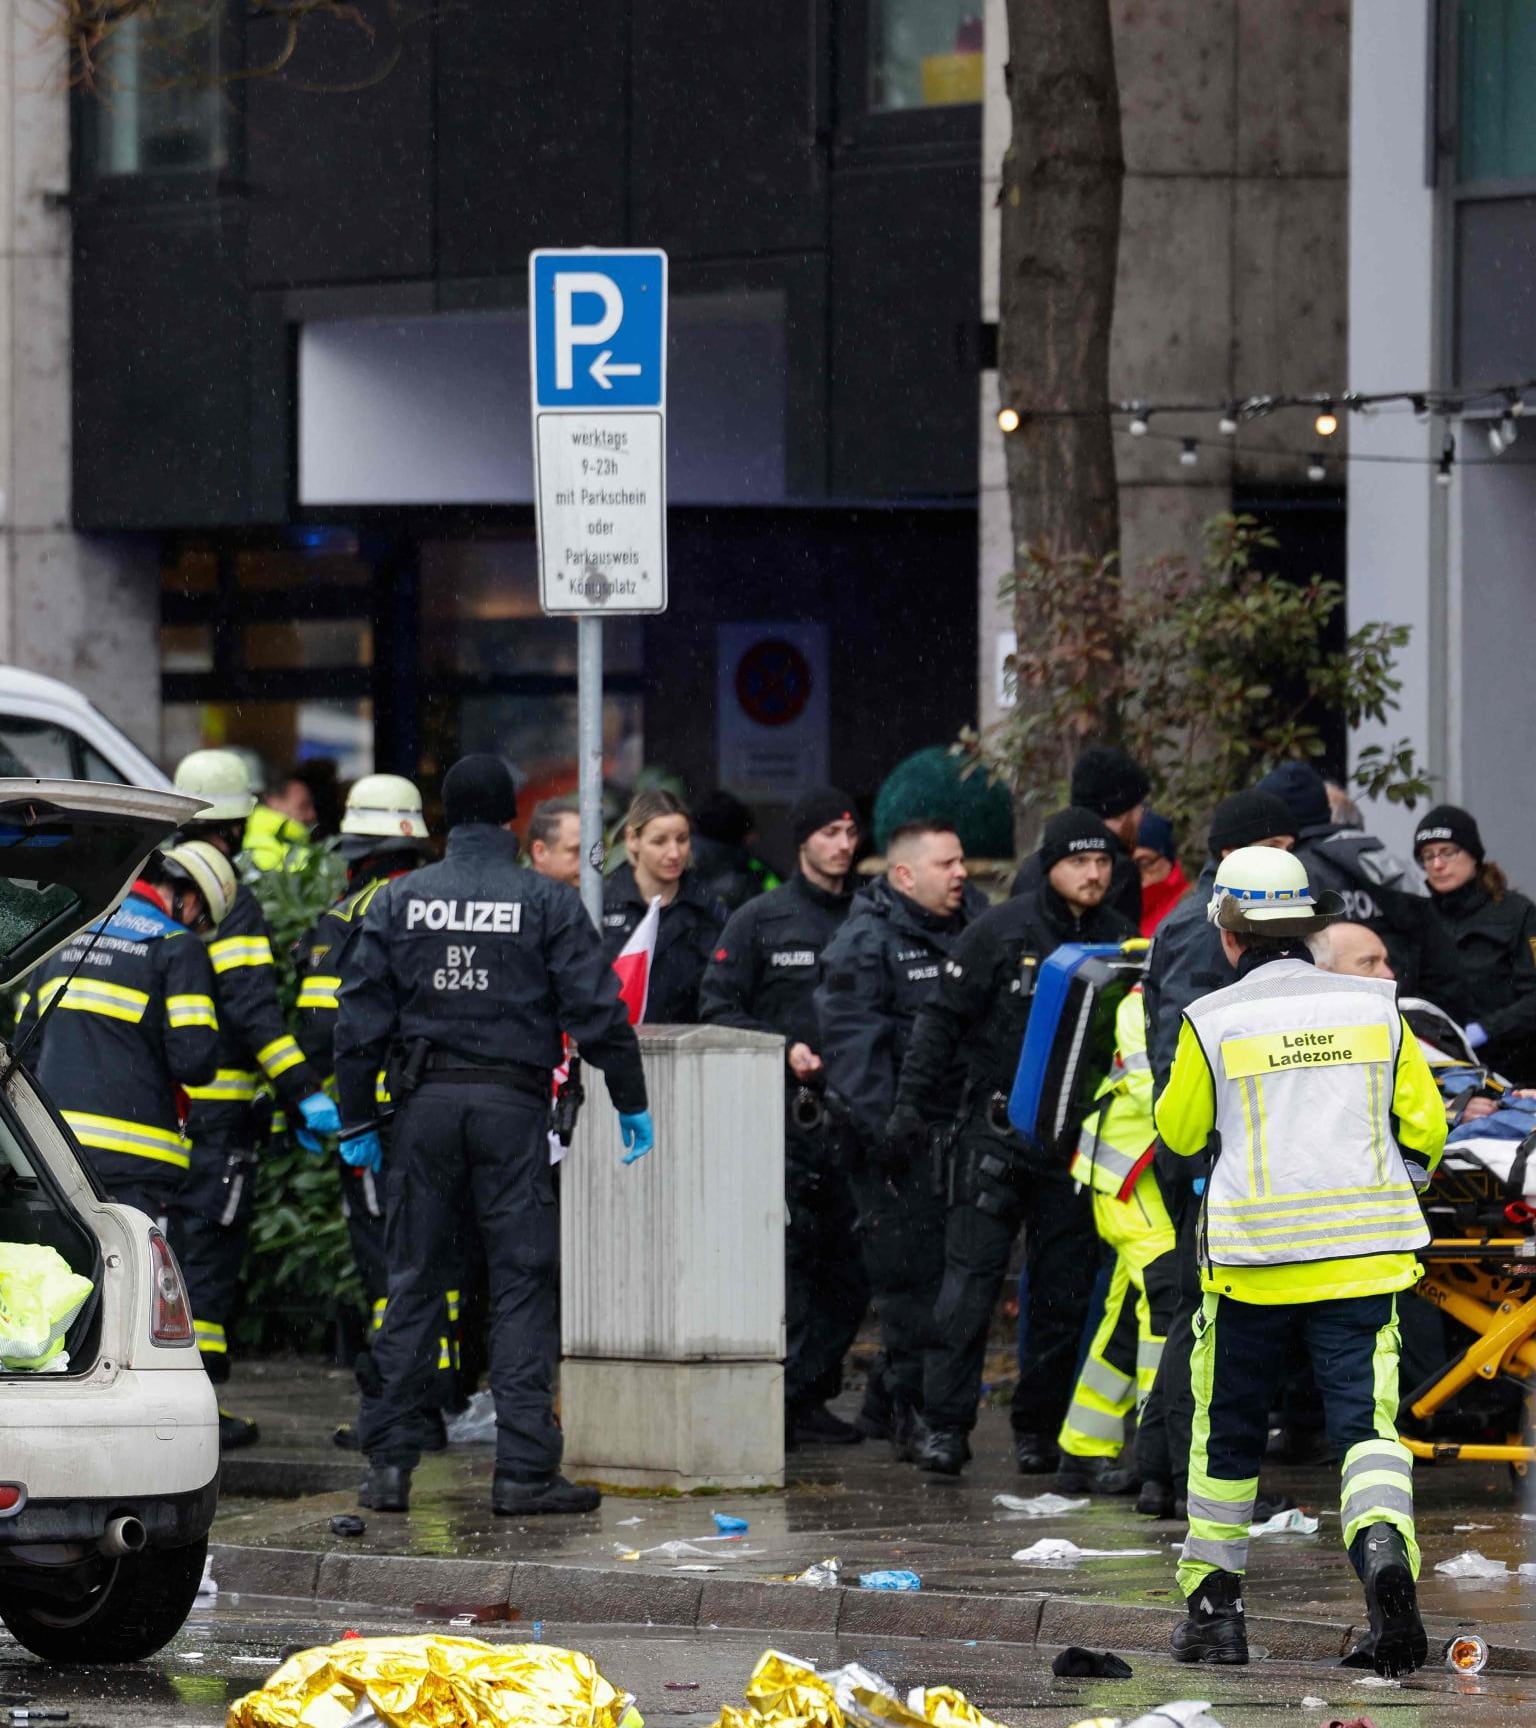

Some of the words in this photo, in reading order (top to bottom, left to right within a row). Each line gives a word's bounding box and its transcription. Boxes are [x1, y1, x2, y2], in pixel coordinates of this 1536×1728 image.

[554, 271, 624, 390] P
[572, 429, 628, 450] werktags
[581, 458, 618, 476] 9-23h
[556, 489, 575, 505] mit
[580, 488, 647, 506] Parkschein
[587, 518, 614, 535] oder
[566, 547, 639, 565] Parkausweis
[569, 577, 637, 599] Königsplatz
[407, 899, 522, 933] POLIZEI
[446, 945, 477, 967] BY
[433, 968, 489, 991] 6243
[1282, 1033, 1335, 1049] Leiter
[1267, 1049, 1353, 1068] Ladezone
